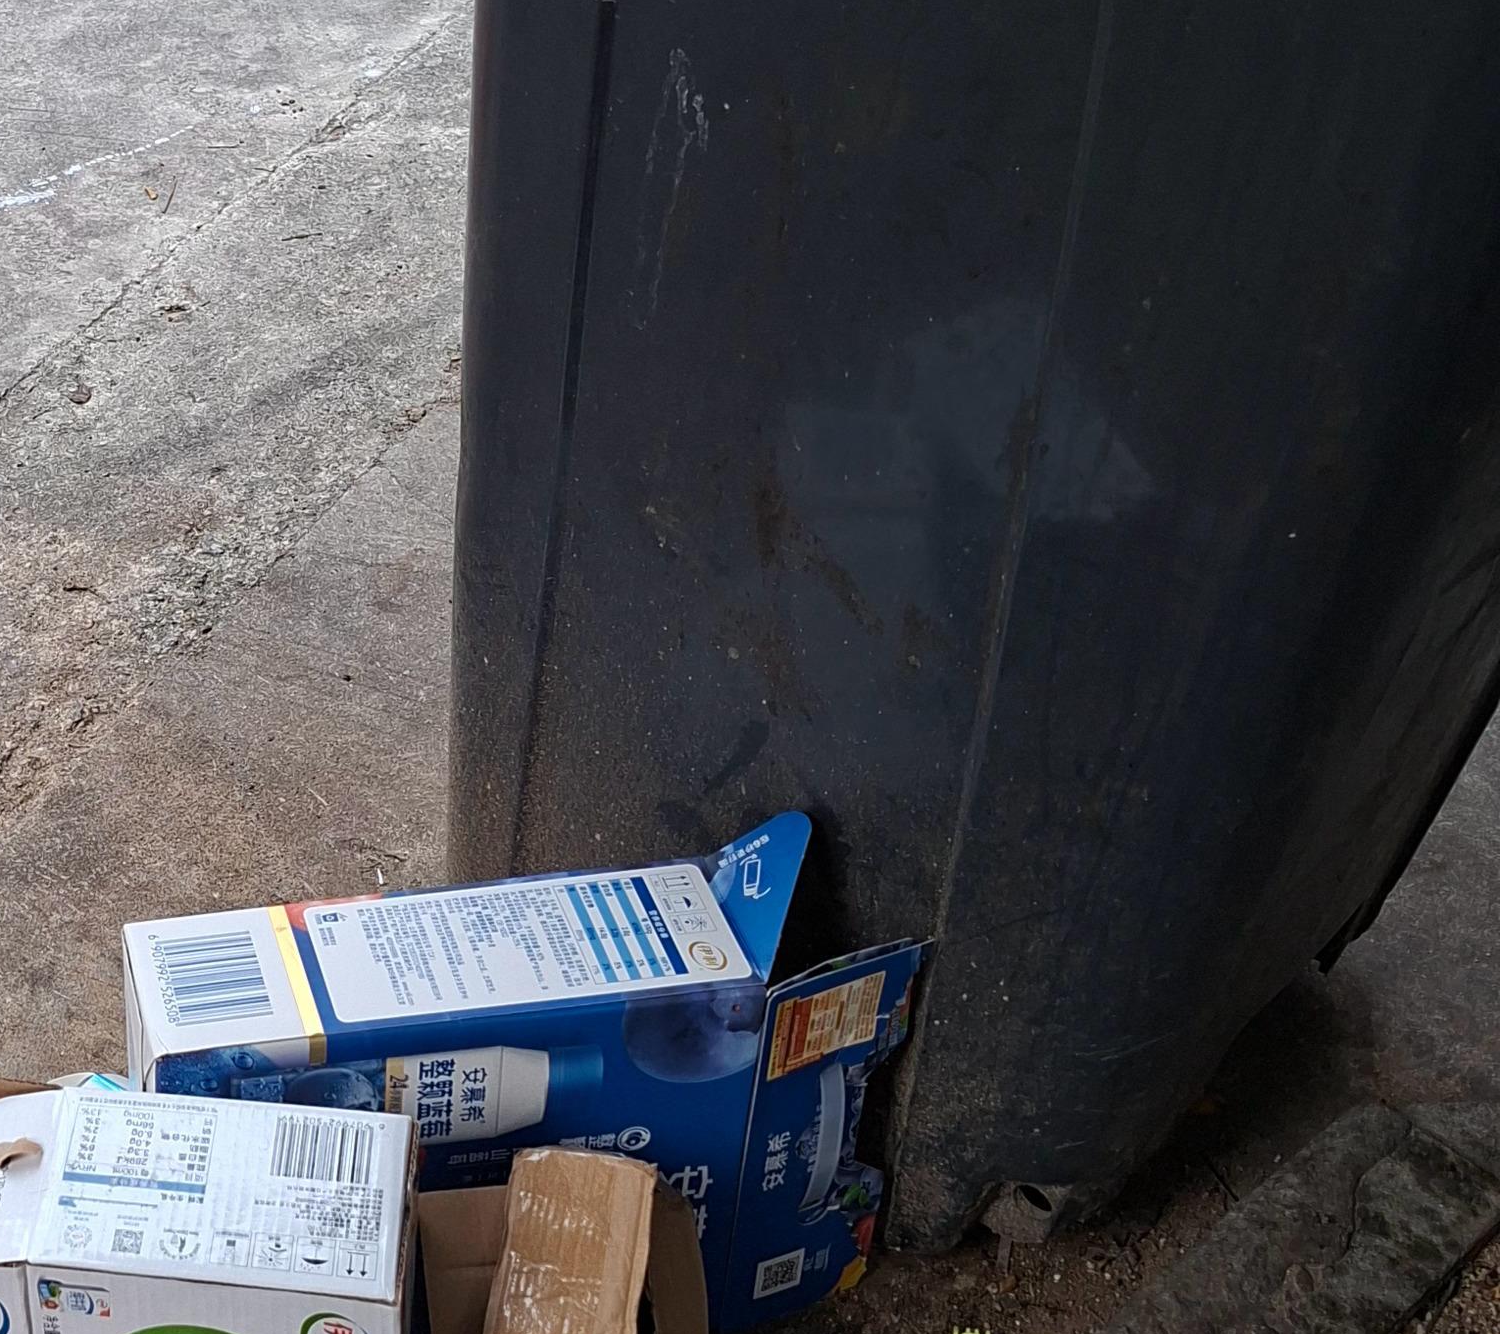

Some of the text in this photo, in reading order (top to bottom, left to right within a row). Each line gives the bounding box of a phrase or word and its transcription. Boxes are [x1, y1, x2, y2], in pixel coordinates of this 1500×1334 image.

[150, 945, 168, 982] 907992
[160, 986, 179, 1024] 526508
[417, 1059, 455, 1138] 整颗蓝莓
[460, 1068, 487, 1121] 安慕希
[127, 1146, 150, 1157] 3.3g
[129, 1137, 151, 1148] 4.0g
[763, 1131, 791, 1191] 安慕希
